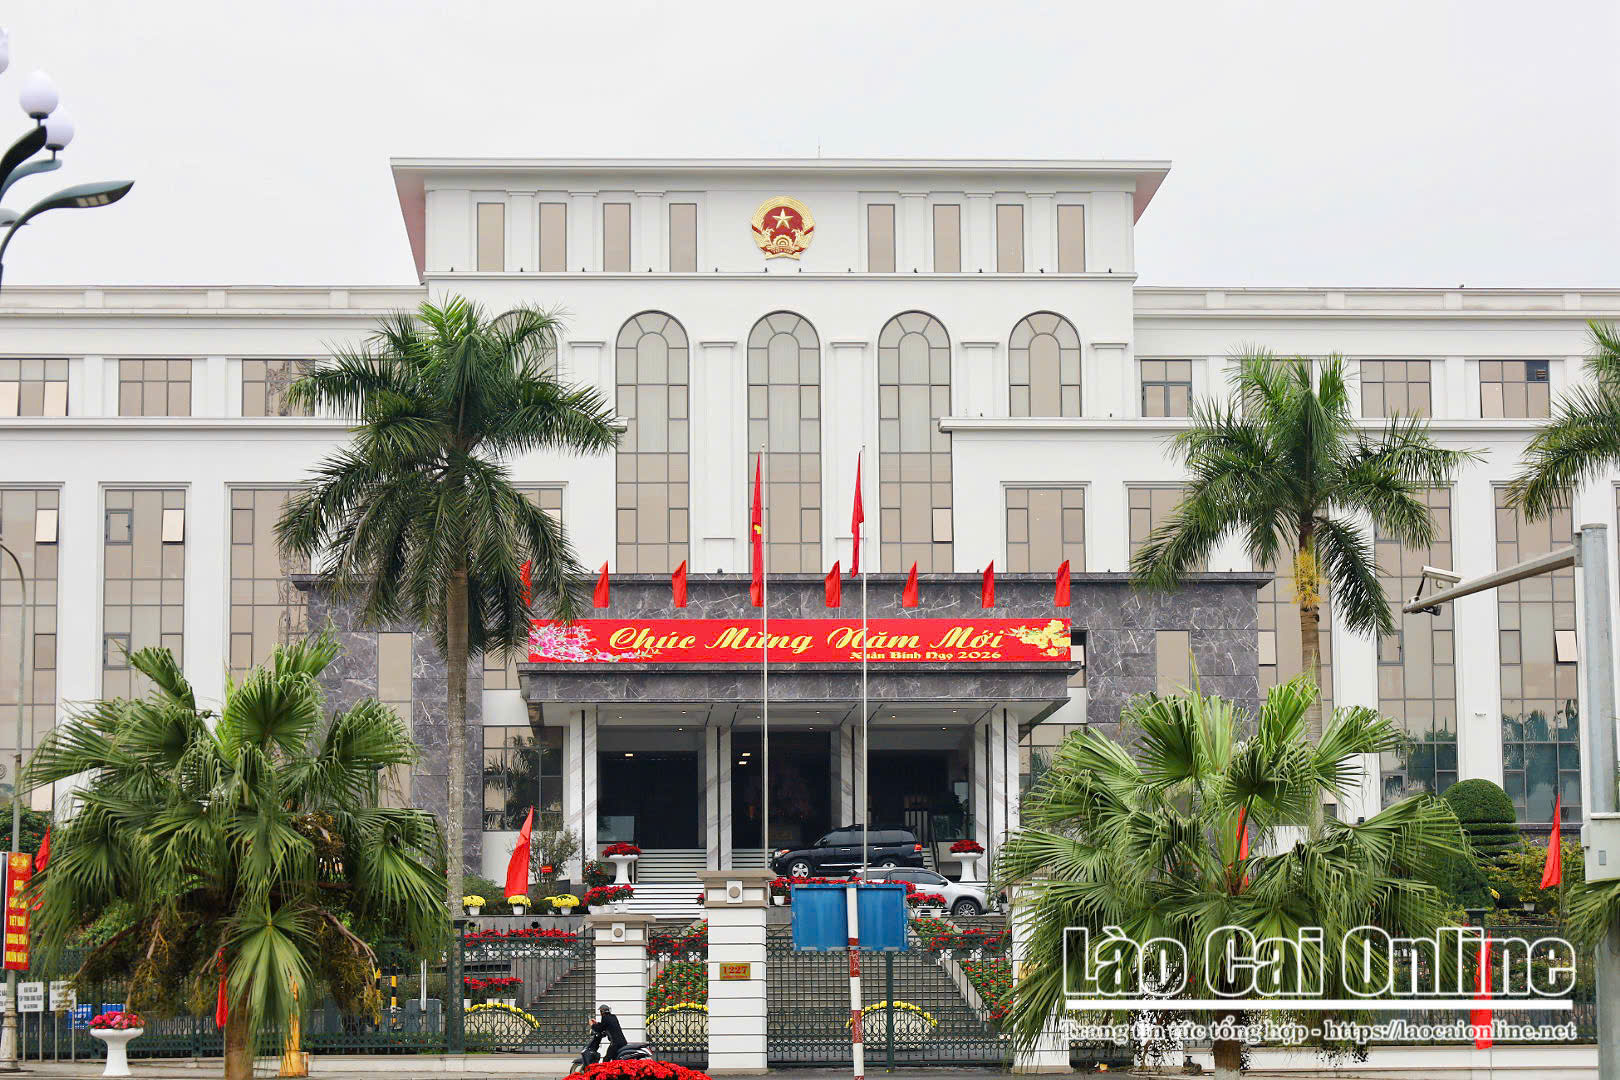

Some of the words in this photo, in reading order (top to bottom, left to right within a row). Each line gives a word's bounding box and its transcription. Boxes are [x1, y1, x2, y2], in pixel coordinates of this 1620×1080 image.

[609, 627, 696, 649] Chúc
[704, 627, 814, 654] Mừng
[827, 627, 921, 649] Năm
[930, 626, 1004, 649] Mới
[958, 651, 1002, 659] 2026
